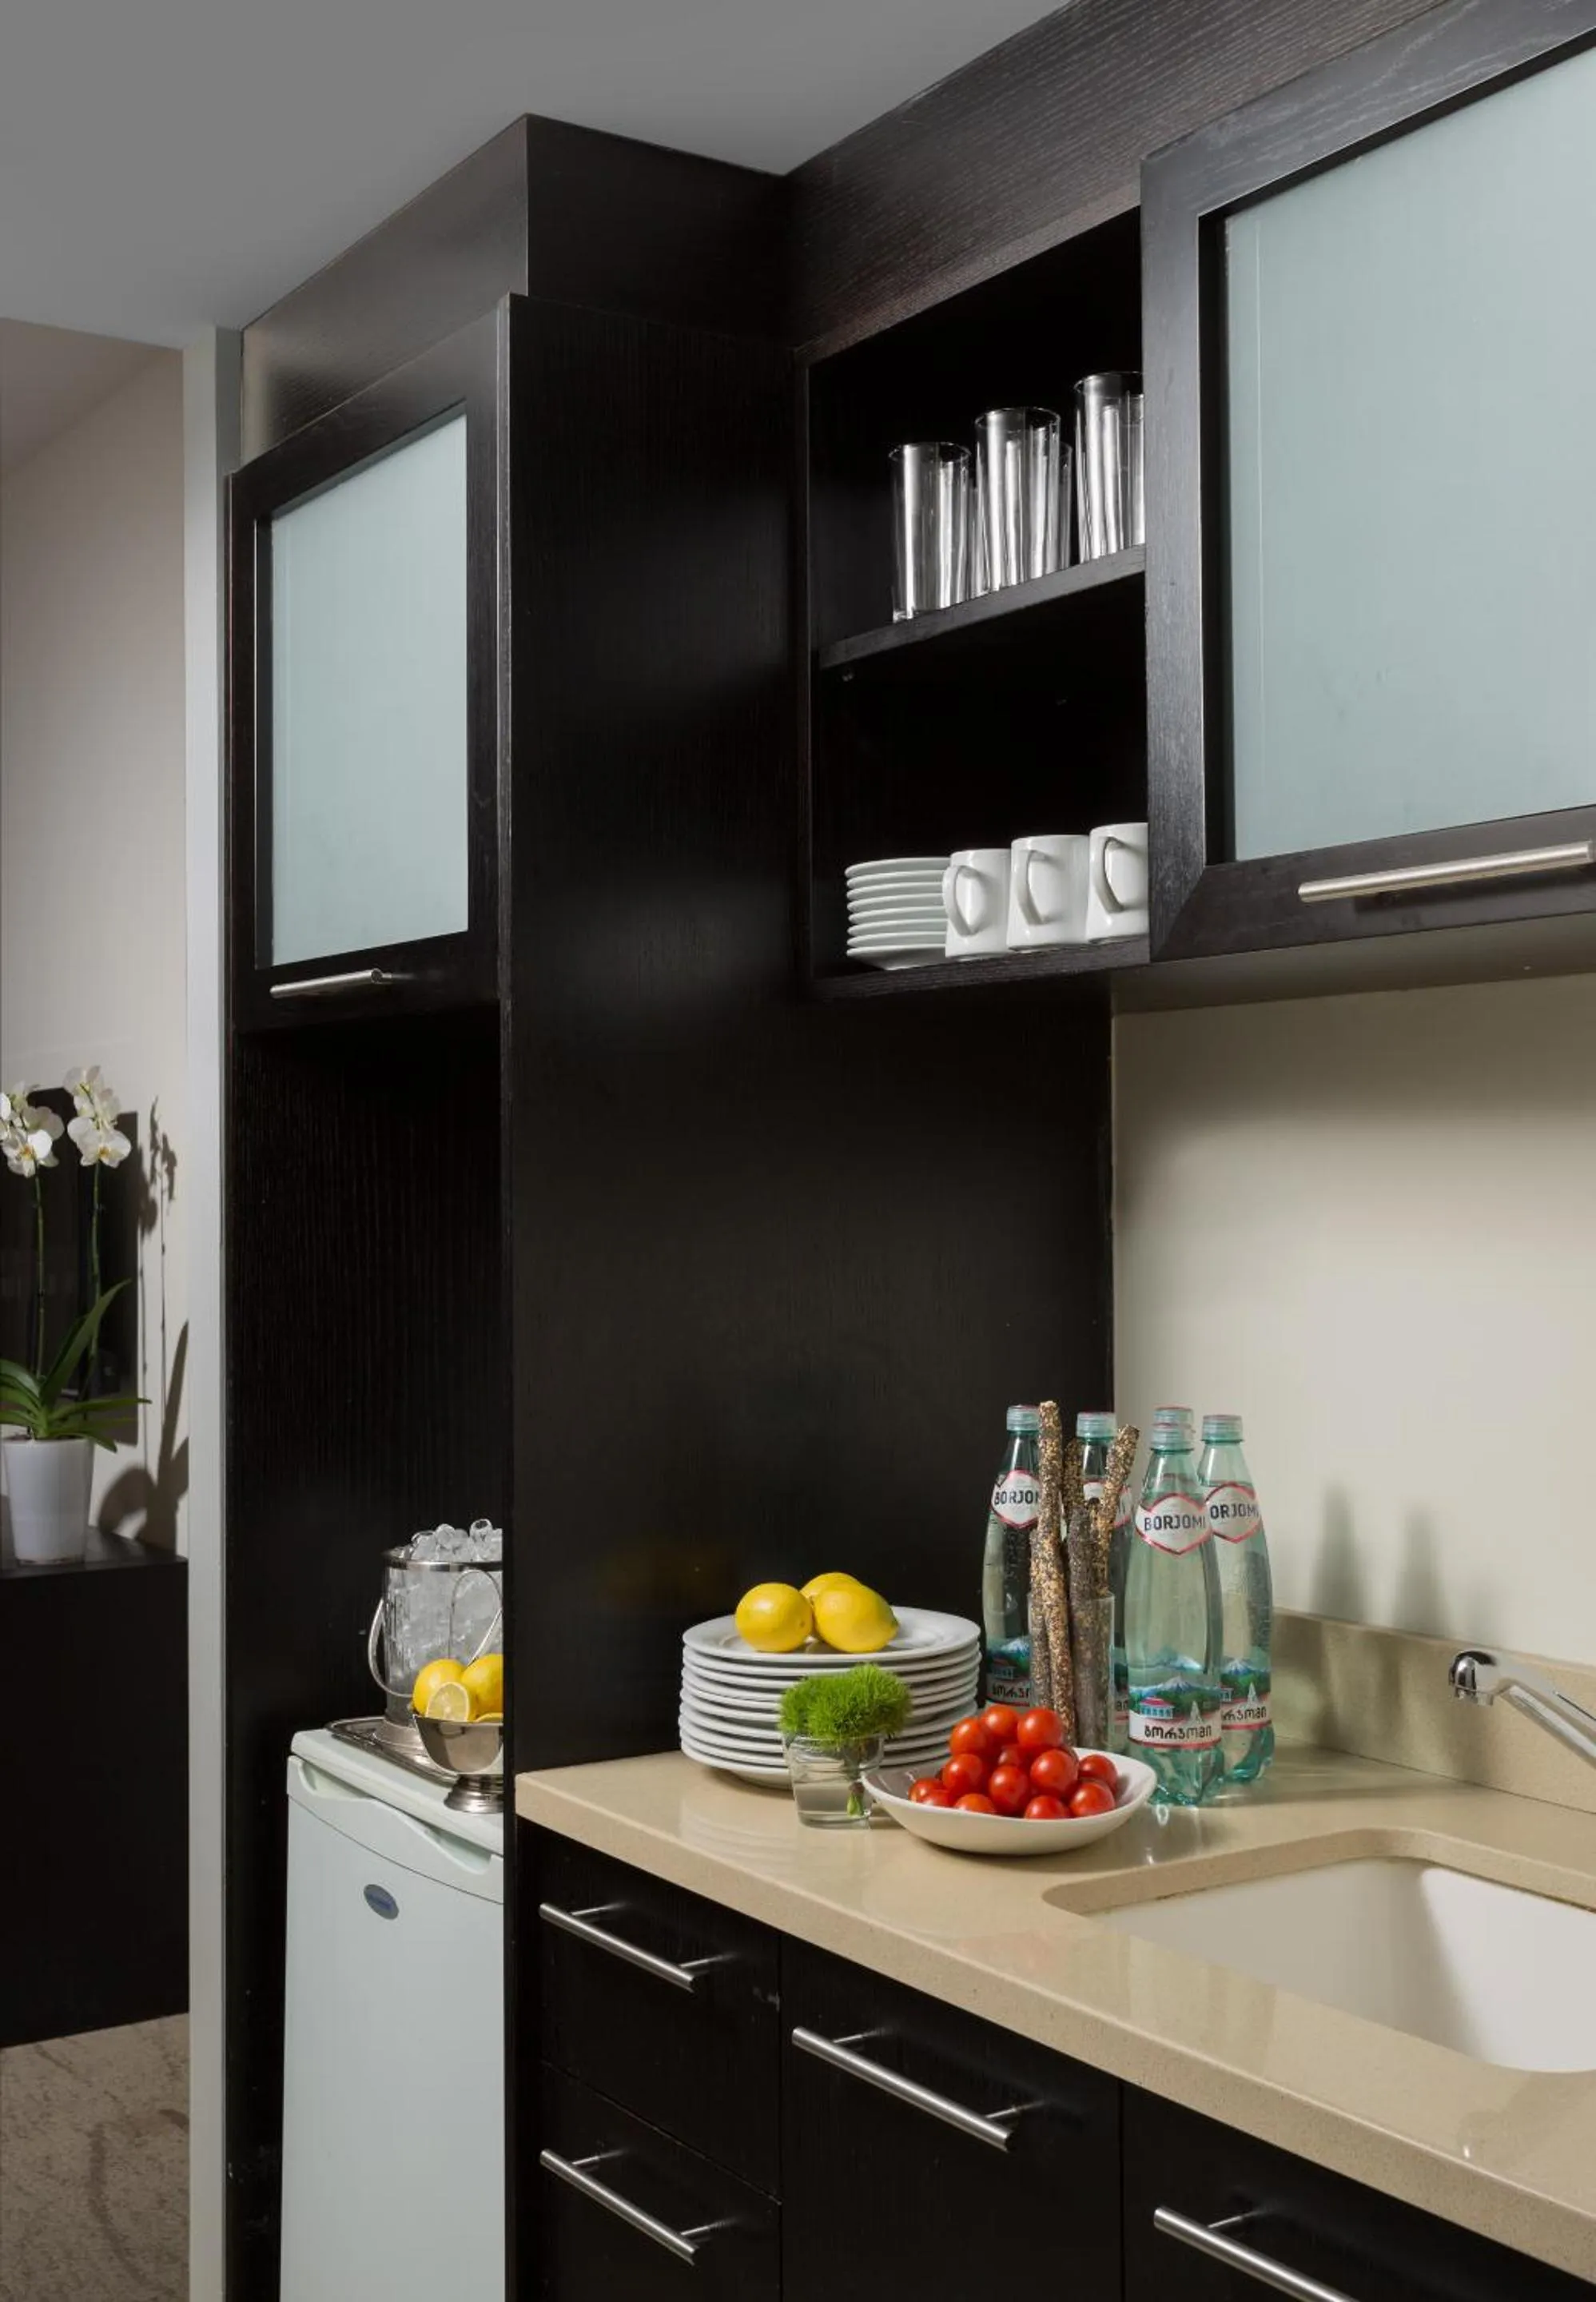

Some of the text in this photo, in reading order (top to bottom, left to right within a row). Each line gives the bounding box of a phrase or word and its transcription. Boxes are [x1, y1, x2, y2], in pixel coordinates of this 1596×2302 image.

[994, 1489, 1039, 1505] BORJO
[1210, 1503, 1259, 1519] ORJOMI
[1144, 1515, 1206, 1531] BORJOMI
